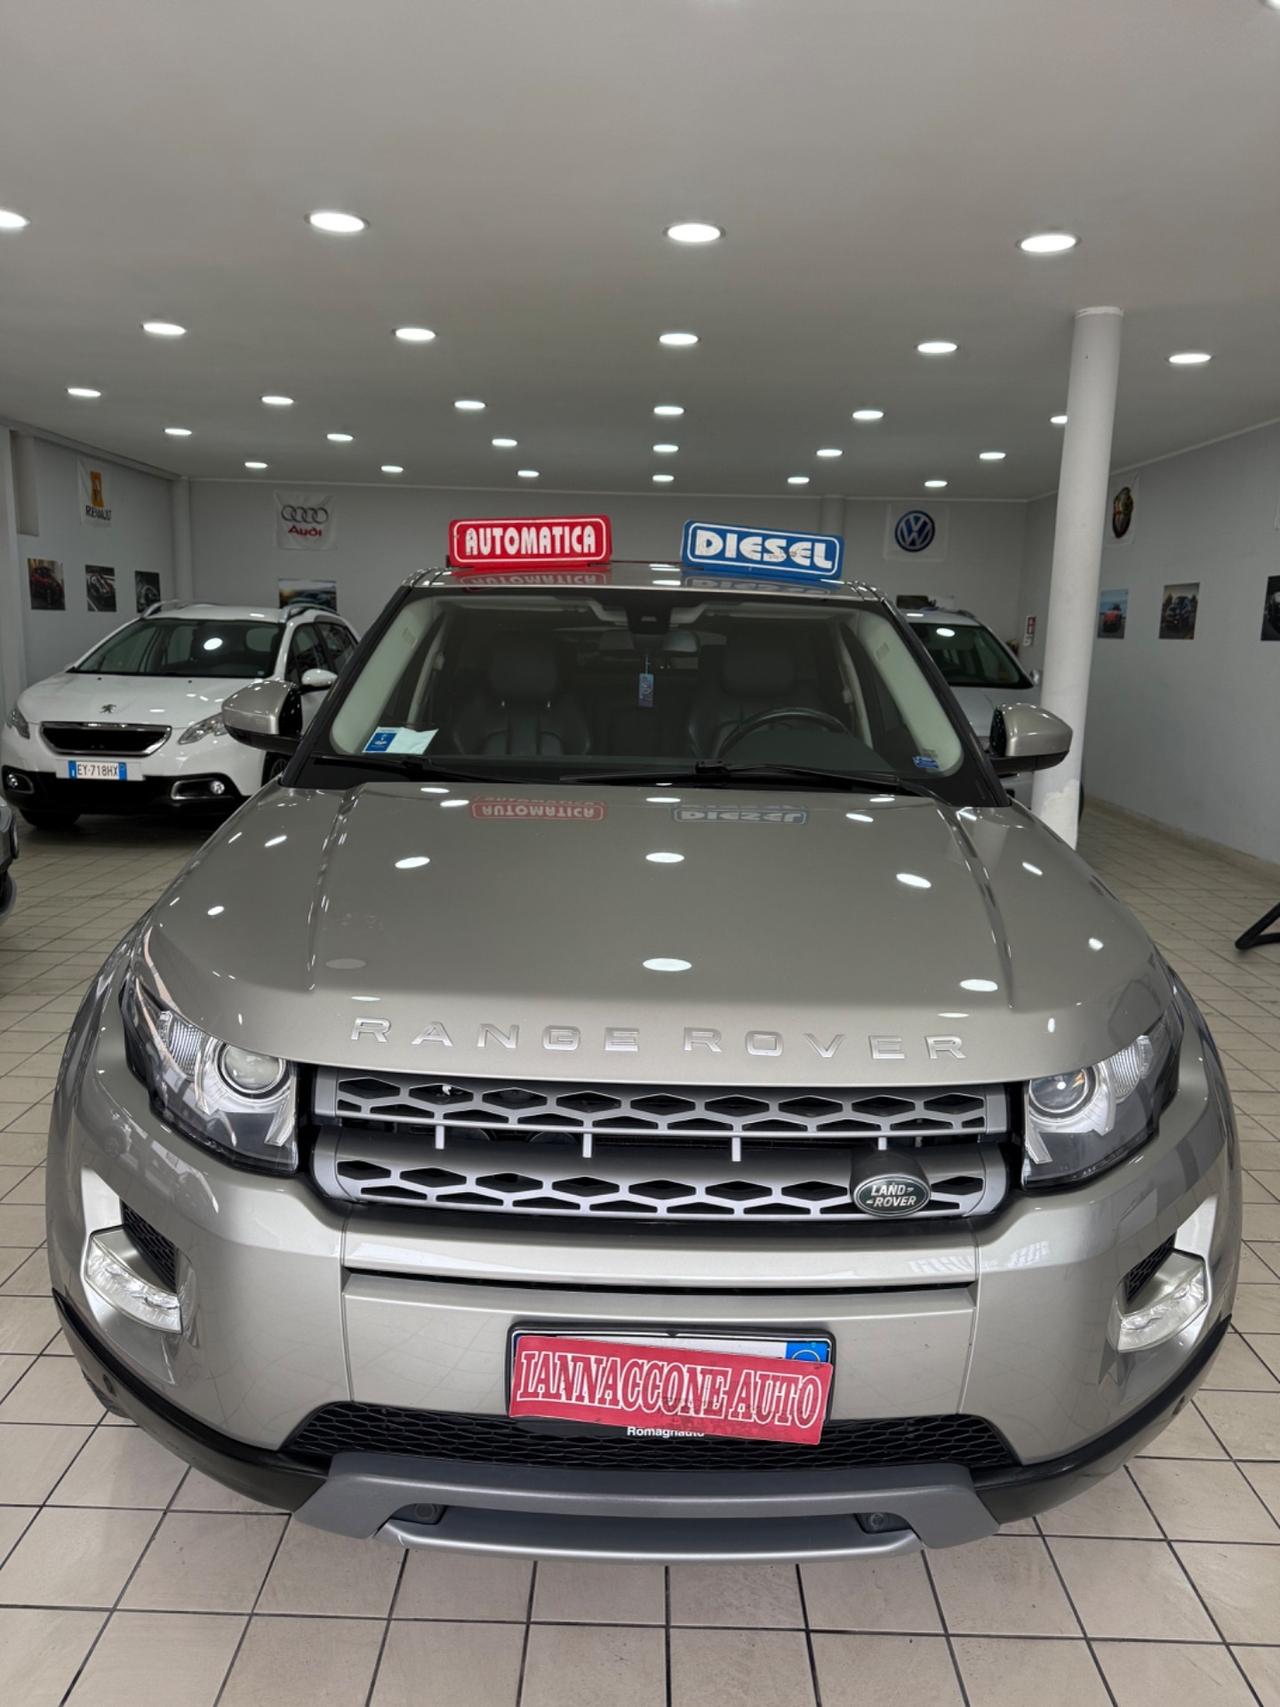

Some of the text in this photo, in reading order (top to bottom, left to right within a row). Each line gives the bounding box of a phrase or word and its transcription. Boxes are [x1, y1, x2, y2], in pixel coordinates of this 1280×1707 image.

[288, 525, 322, 537] Audi
[465, 524, 597, 556] AUTOMATICA
[694, 529, 834, 569] DIESEL
[351, 1016, 967, 1060] RANGE ROVER
[870, 1183, 907, 1197] LAND
[873, 1195, 918, 1208] ROVER
[516, 1350, 823, 1429] IANNACCONE AUTO
